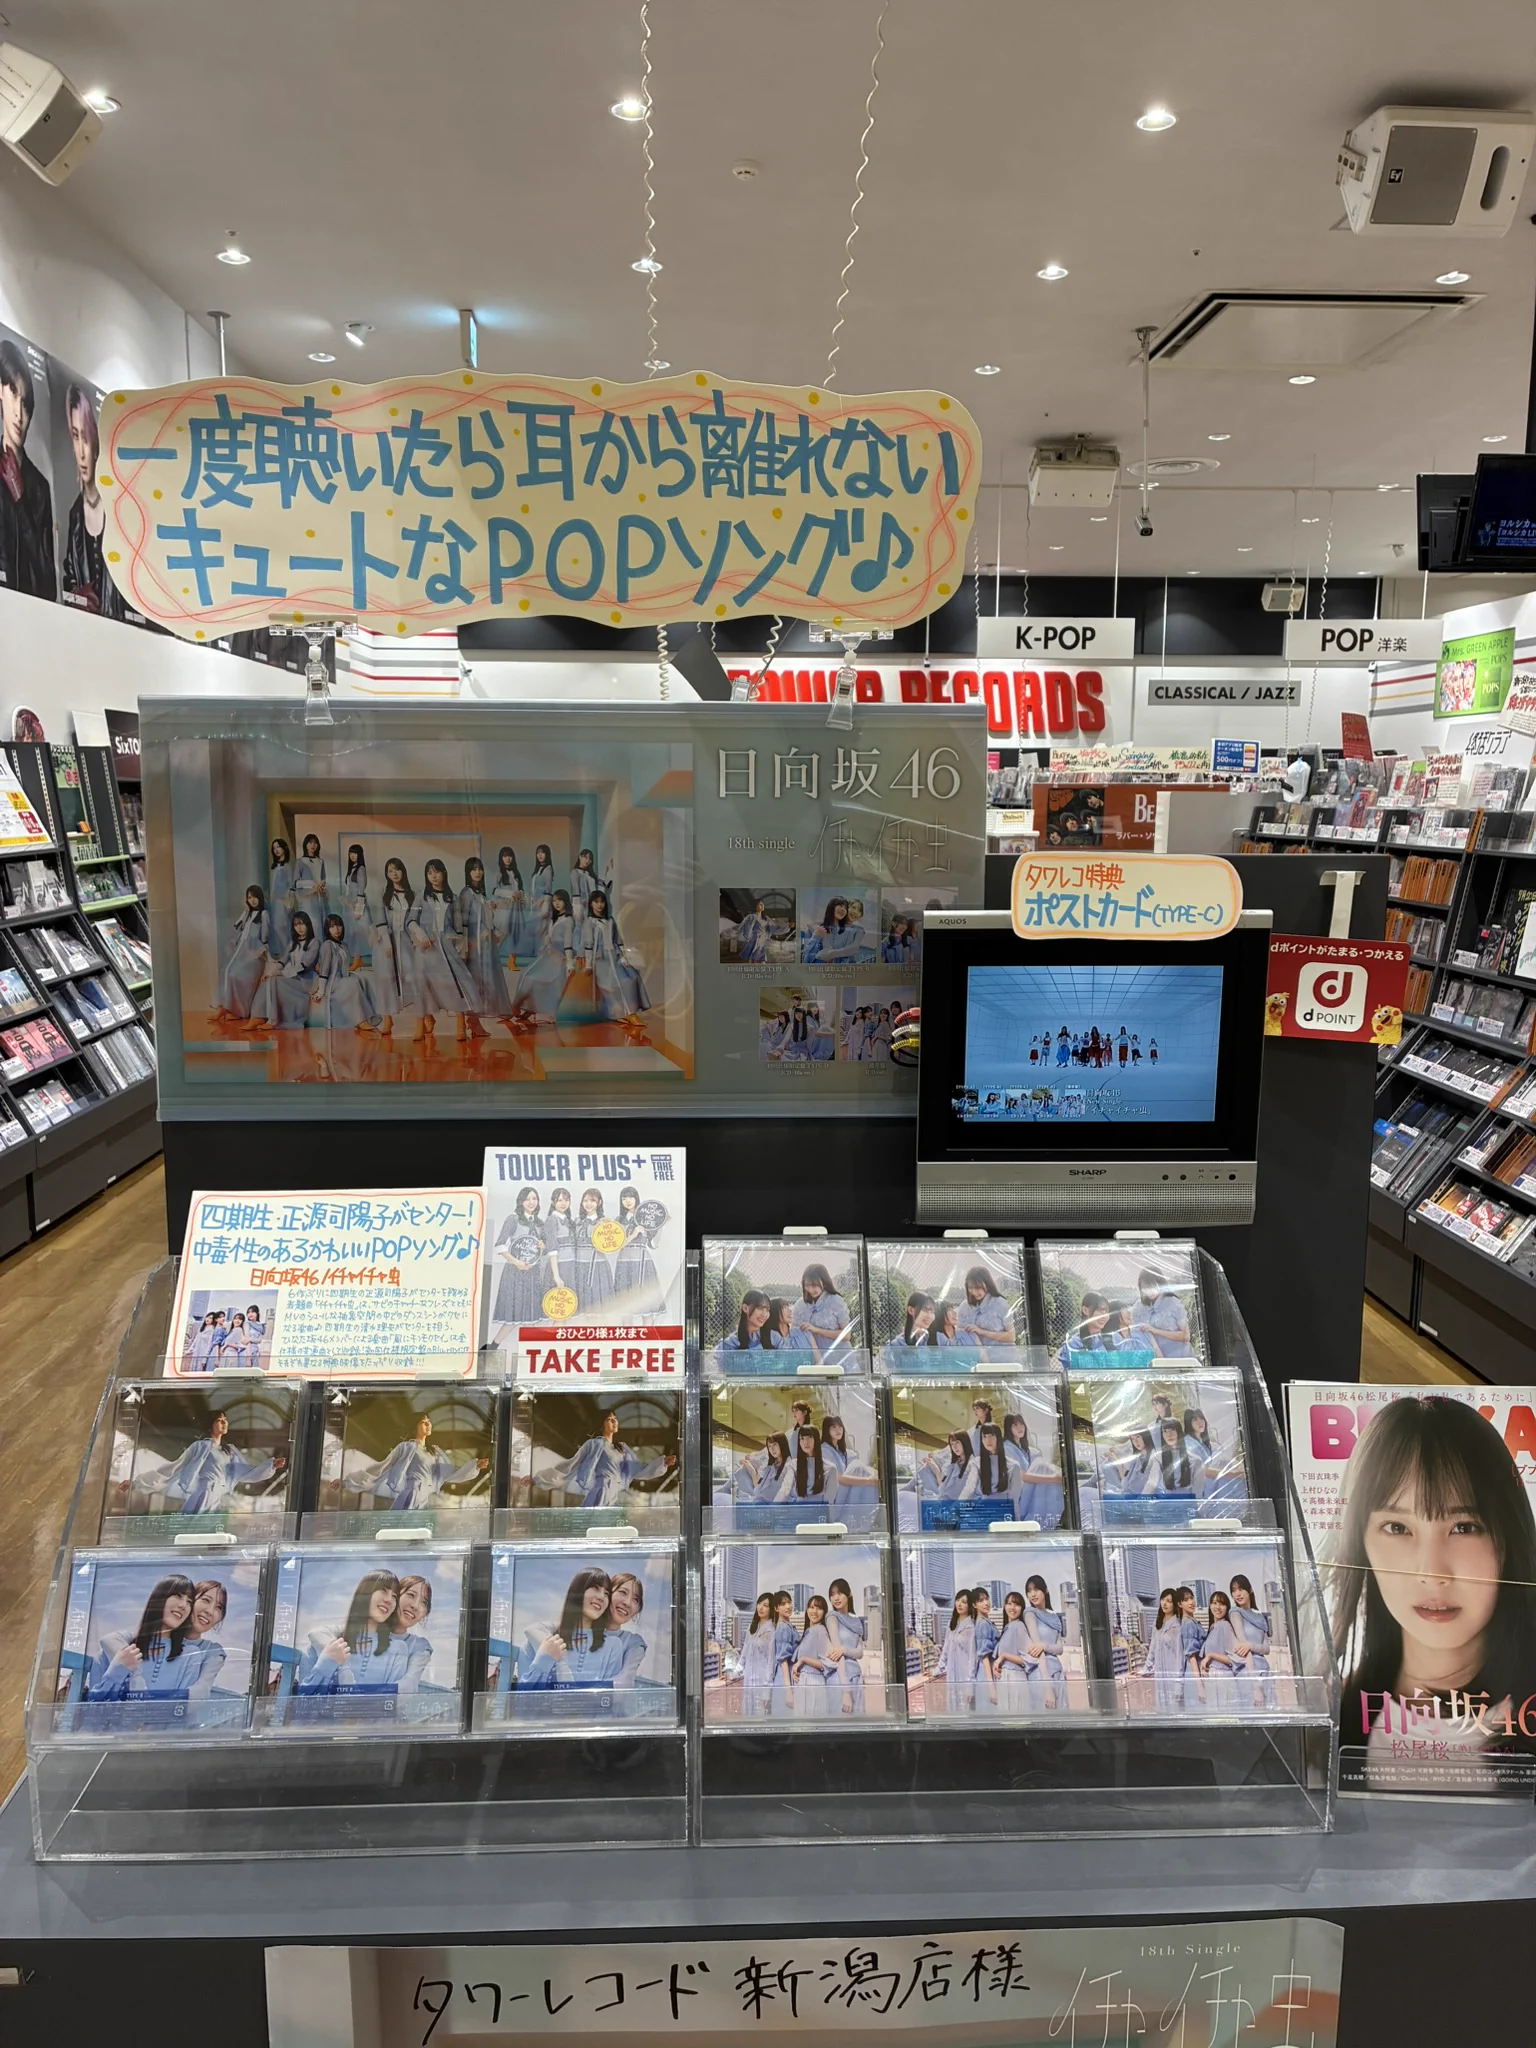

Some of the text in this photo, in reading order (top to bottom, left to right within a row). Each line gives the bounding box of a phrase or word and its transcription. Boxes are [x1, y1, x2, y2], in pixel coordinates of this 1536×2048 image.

[118, 389, 960, 509] 一度聴いたら耳から離れない
[1016, 626, 1096, 651] K-POP
[1321, 628, 1407, 652] POP 洋楽
[1467, 643, 1486, 654] GREEN
[1488, 637, 1508, 651] APPLE
[1154, 685, 1237, 701] CLASSICAL
[1254, 685, 1296, 701] JAZZ
[718, 746, 961, 800] 日向坂46
[727, 837, 754, 849] 18th
[758, 837, 796, 852] single
[1116, 831, 1156, 841] ラバー・ソ
[1025, 862, 1125, 891] タワレコ特典
[938, 918, 967, 926] AQUOS
[1270, 942, 1404, 961] dポイントがたまる・つかえる
[1316, 1012, 1356, 1025] POINT
[495, 1154, 647, 1181] TOWER PLUS+
[651, 1162, 673, 1171] TAKE
[653, 1171, 675, 1181] FREE
[556, 1327, 648, 1340] おひとり様1枚まで
[526, 1348, 675, 1373] TAKE FREE
[1300, 1486, 1338, 1495] 上村ひなの
[1360, 1687, 1536, 1737] 日向坂46
[1391, 1739, 1450, 1761] 松尾桜
[1140, 1942, 1242, 1958] 18th Single
[413, 1940, 1031, 2046] タワーレコード 新潟店様
